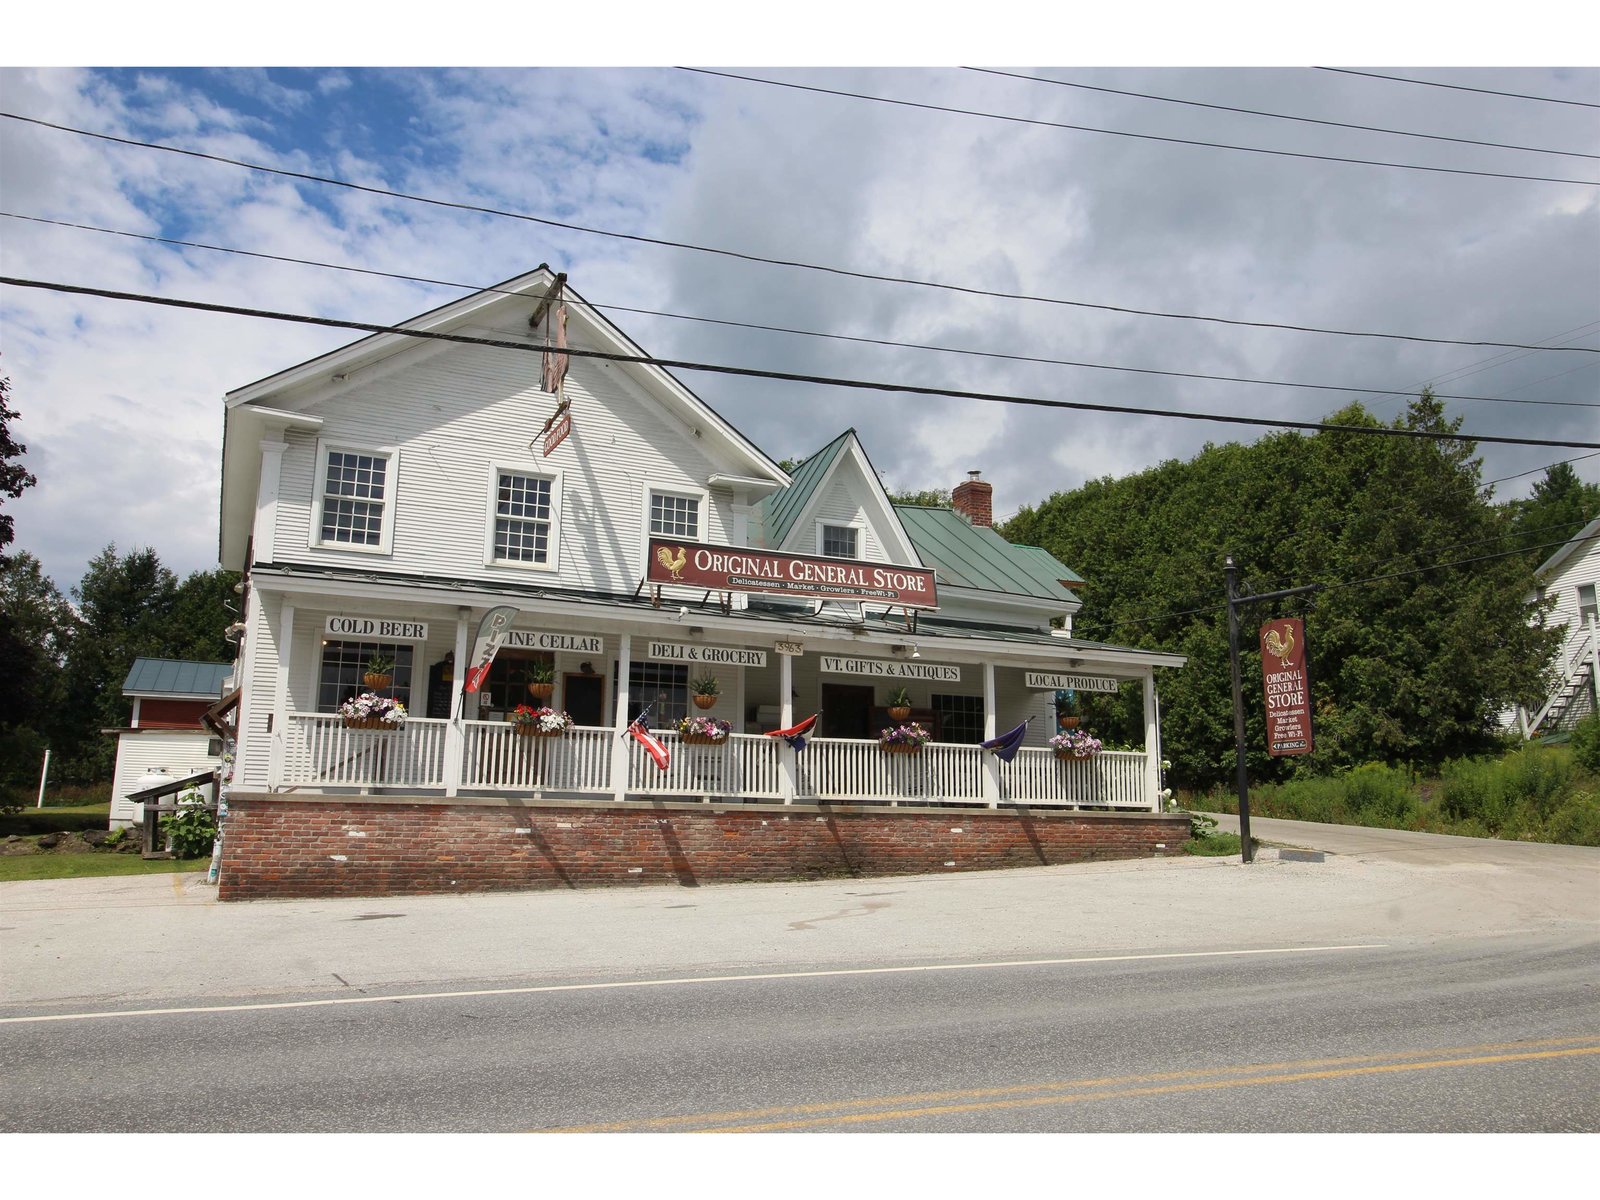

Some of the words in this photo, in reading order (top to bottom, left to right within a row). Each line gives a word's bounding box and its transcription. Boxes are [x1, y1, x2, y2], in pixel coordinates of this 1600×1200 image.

[557, 420, 569, 441] FOOD
[695, 549, 783, 578] ORIGINAL
[789, 560, 869, 586] GENERAL
[873, 569, 926, 592] STORE
[732, 577, 780, 588] Delicatessen
[787, 582, 815, 591] Market
[820, 585, 855, 594] Growlers
[329, 618, 375, 634] COLD
[379, 621, 424, 638] BEER
[502, 631, 535, 647] INE
[540, 634, 600, 652] CELLAR
[777, 642, 802, 653] 3963
[652, 643, 684, 659] DELI
[688, 648, 698, 660] &
[702, 647, 764, 665] GROCERY
[824, 658, 843, 671] VT.
[846, 660, 883, 674] GIFTS
[886, 664, 895, 675] &
[899, 664, 958, 680] ANTIQUES
[1266, 670, 1302, 684] ORIGINAL
[1029, 674, 1065, 688] LOCAL
[1066, 676, 1116, 691] PRODUCE
[1267, 681, 1304, 695] GENERAL
[1268, 691, 1304, 709] STORE
[1269, 709, 1305, 718] Delicatessen
[1277, 716, 1298, 724] Market
[1274, 724, 1301, 732] Growlers
